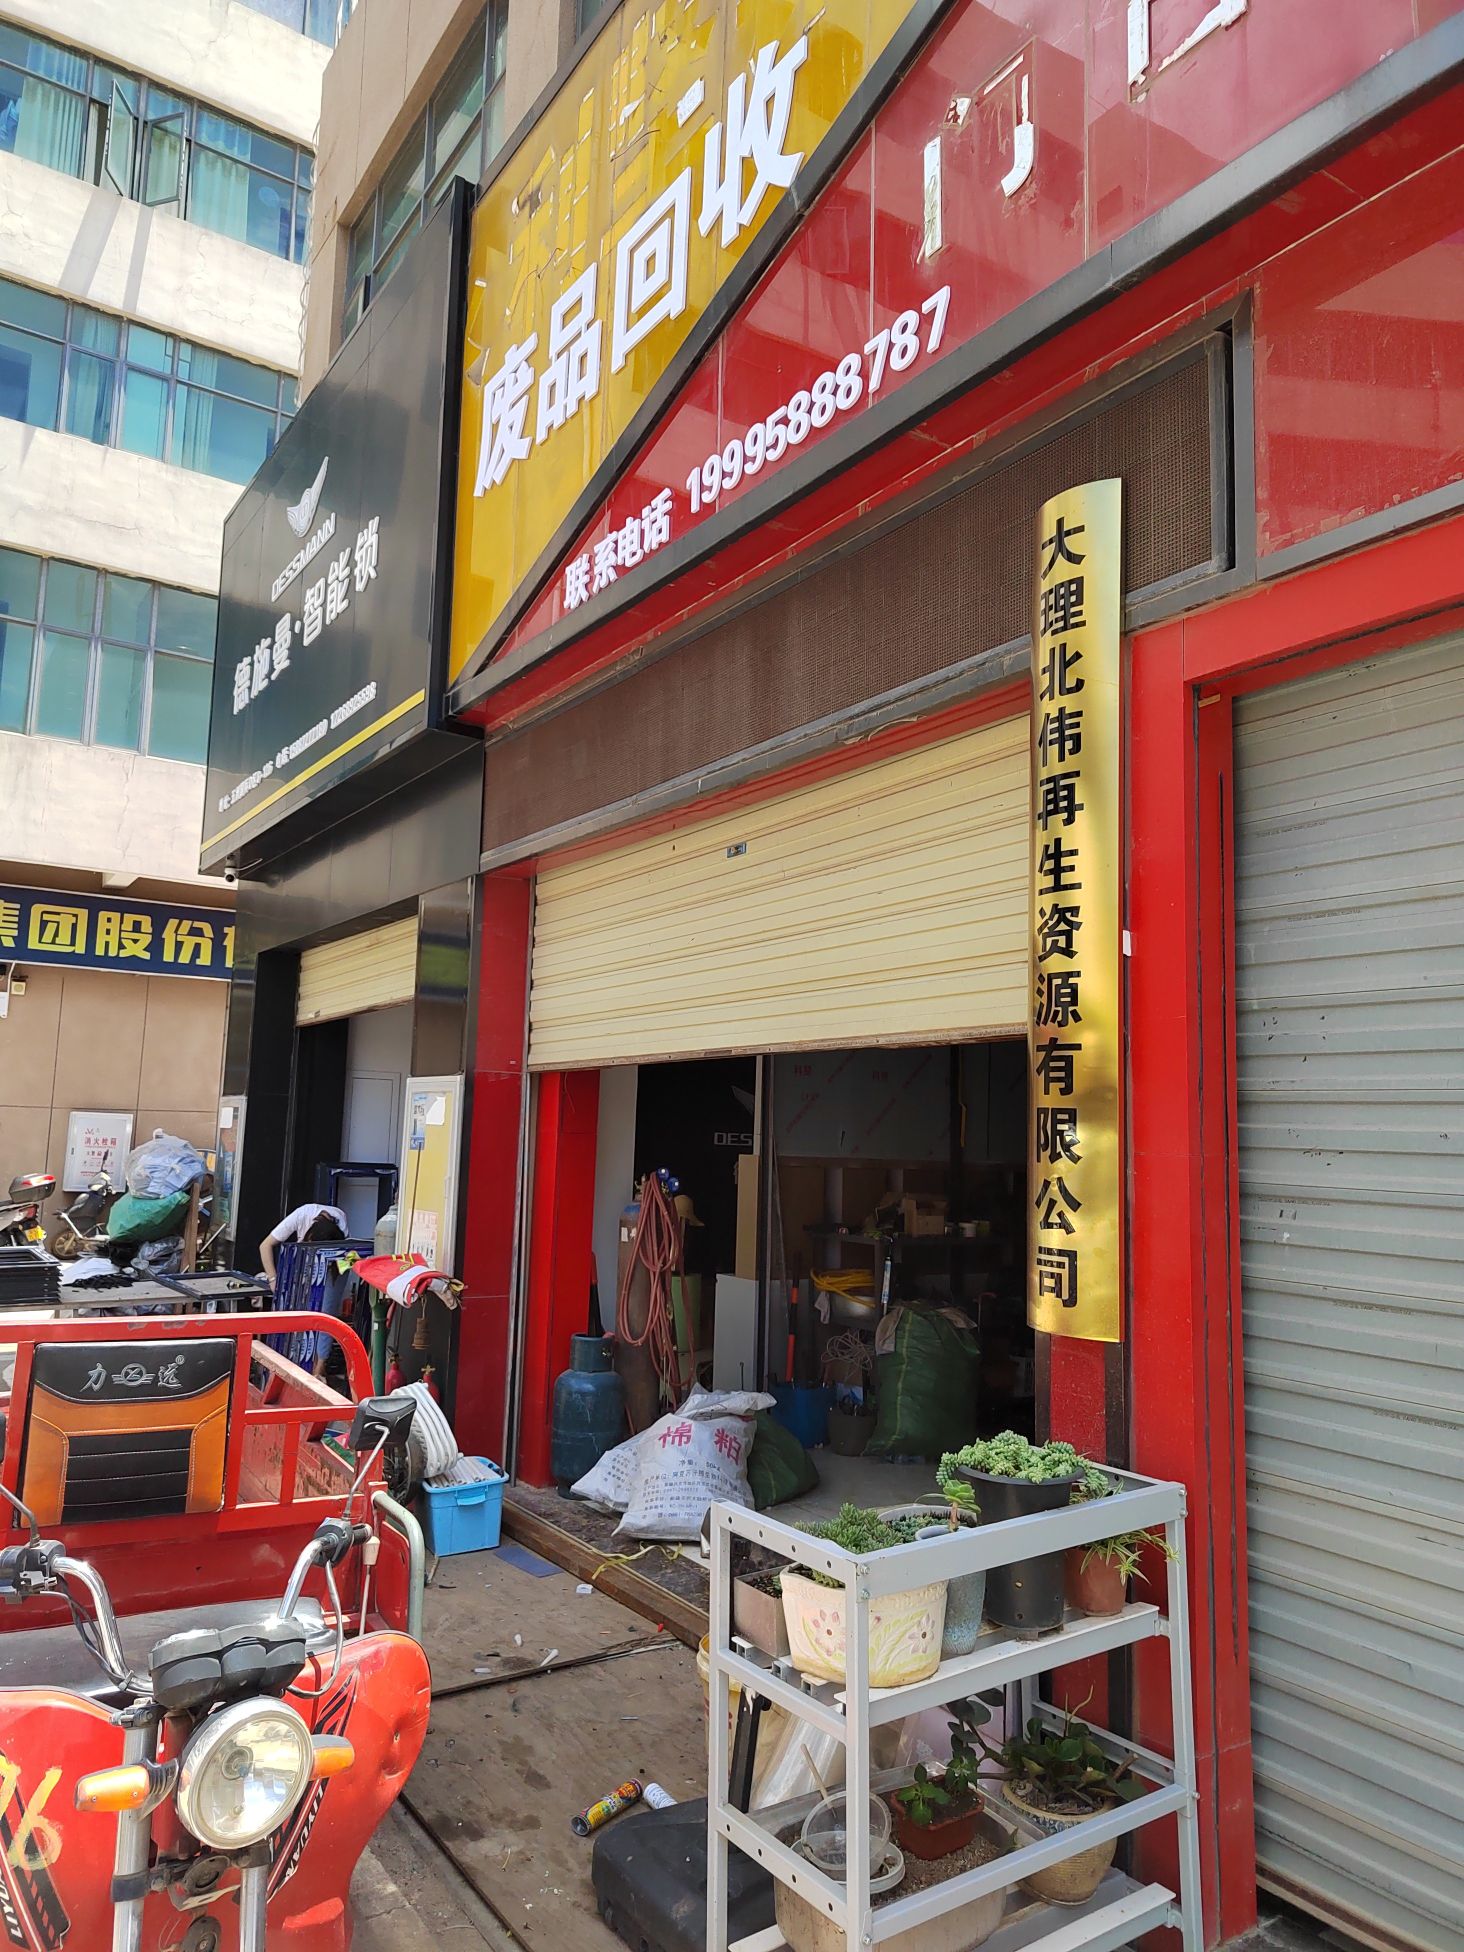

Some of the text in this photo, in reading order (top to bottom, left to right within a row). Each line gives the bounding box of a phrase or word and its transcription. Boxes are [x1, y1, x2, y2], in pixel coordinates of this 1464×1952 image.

[473, 34, 809, 498] 废品回收
[271, 512, 336, 603] DESSMANN
[562, 284, 951, 610] 联系电话 19995888787
[0, 898, 236, 969] 团股份
[1036, 517, 1086, 1309] 大理北伟再生资源有限公司
